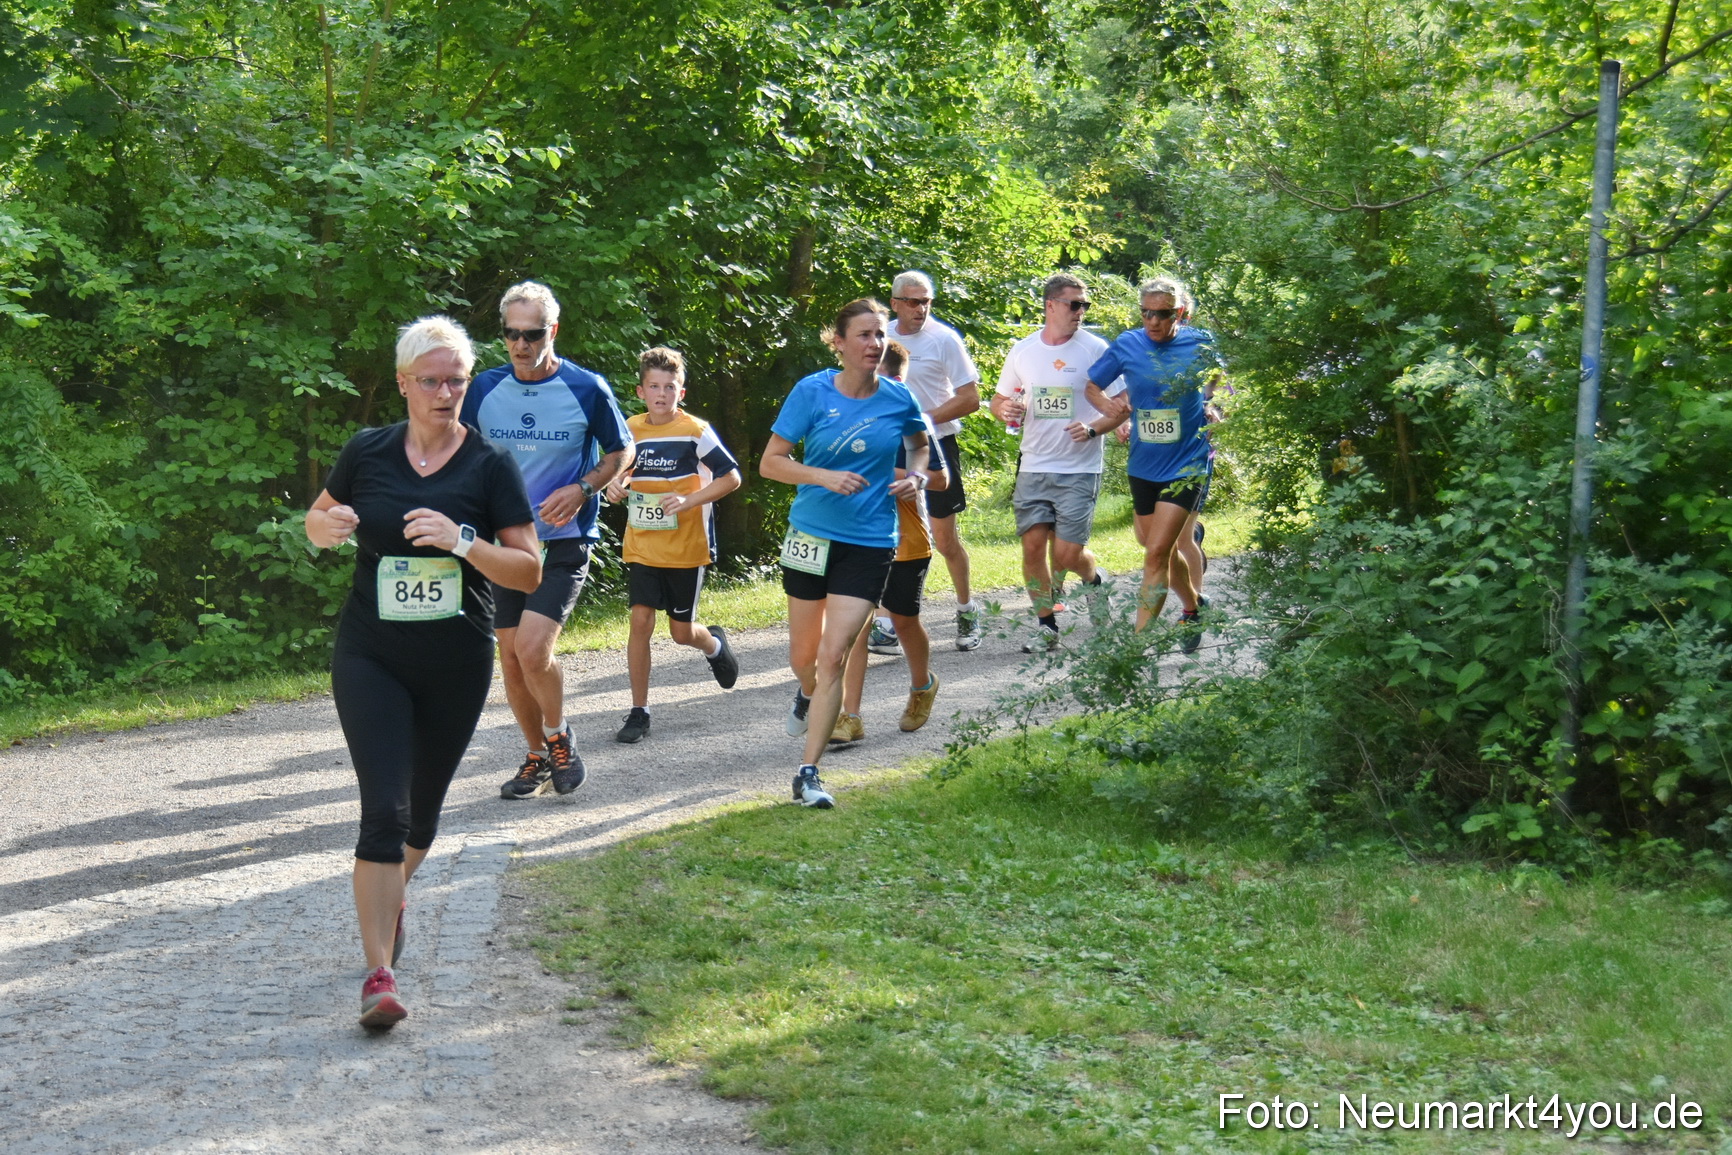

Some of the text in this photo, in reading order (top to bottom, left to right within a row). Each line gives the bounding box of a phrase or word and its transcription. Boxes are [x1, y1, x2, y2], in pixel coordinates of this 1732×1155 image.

[1037, 398, 1068, 410] 1345
[489, 428, 570, 441] SCHABMÜLLER
[1141, 421, 1174, 434] 1088
[827, 436, 843, 452] Team
[841, 421, 864, 437] Schick
[516, 444, 537, 452] TEAM
[636, 505, 664, 520] 759
[786, 539, 819, 561] 1531
[395, 580, 443, 602] 845
